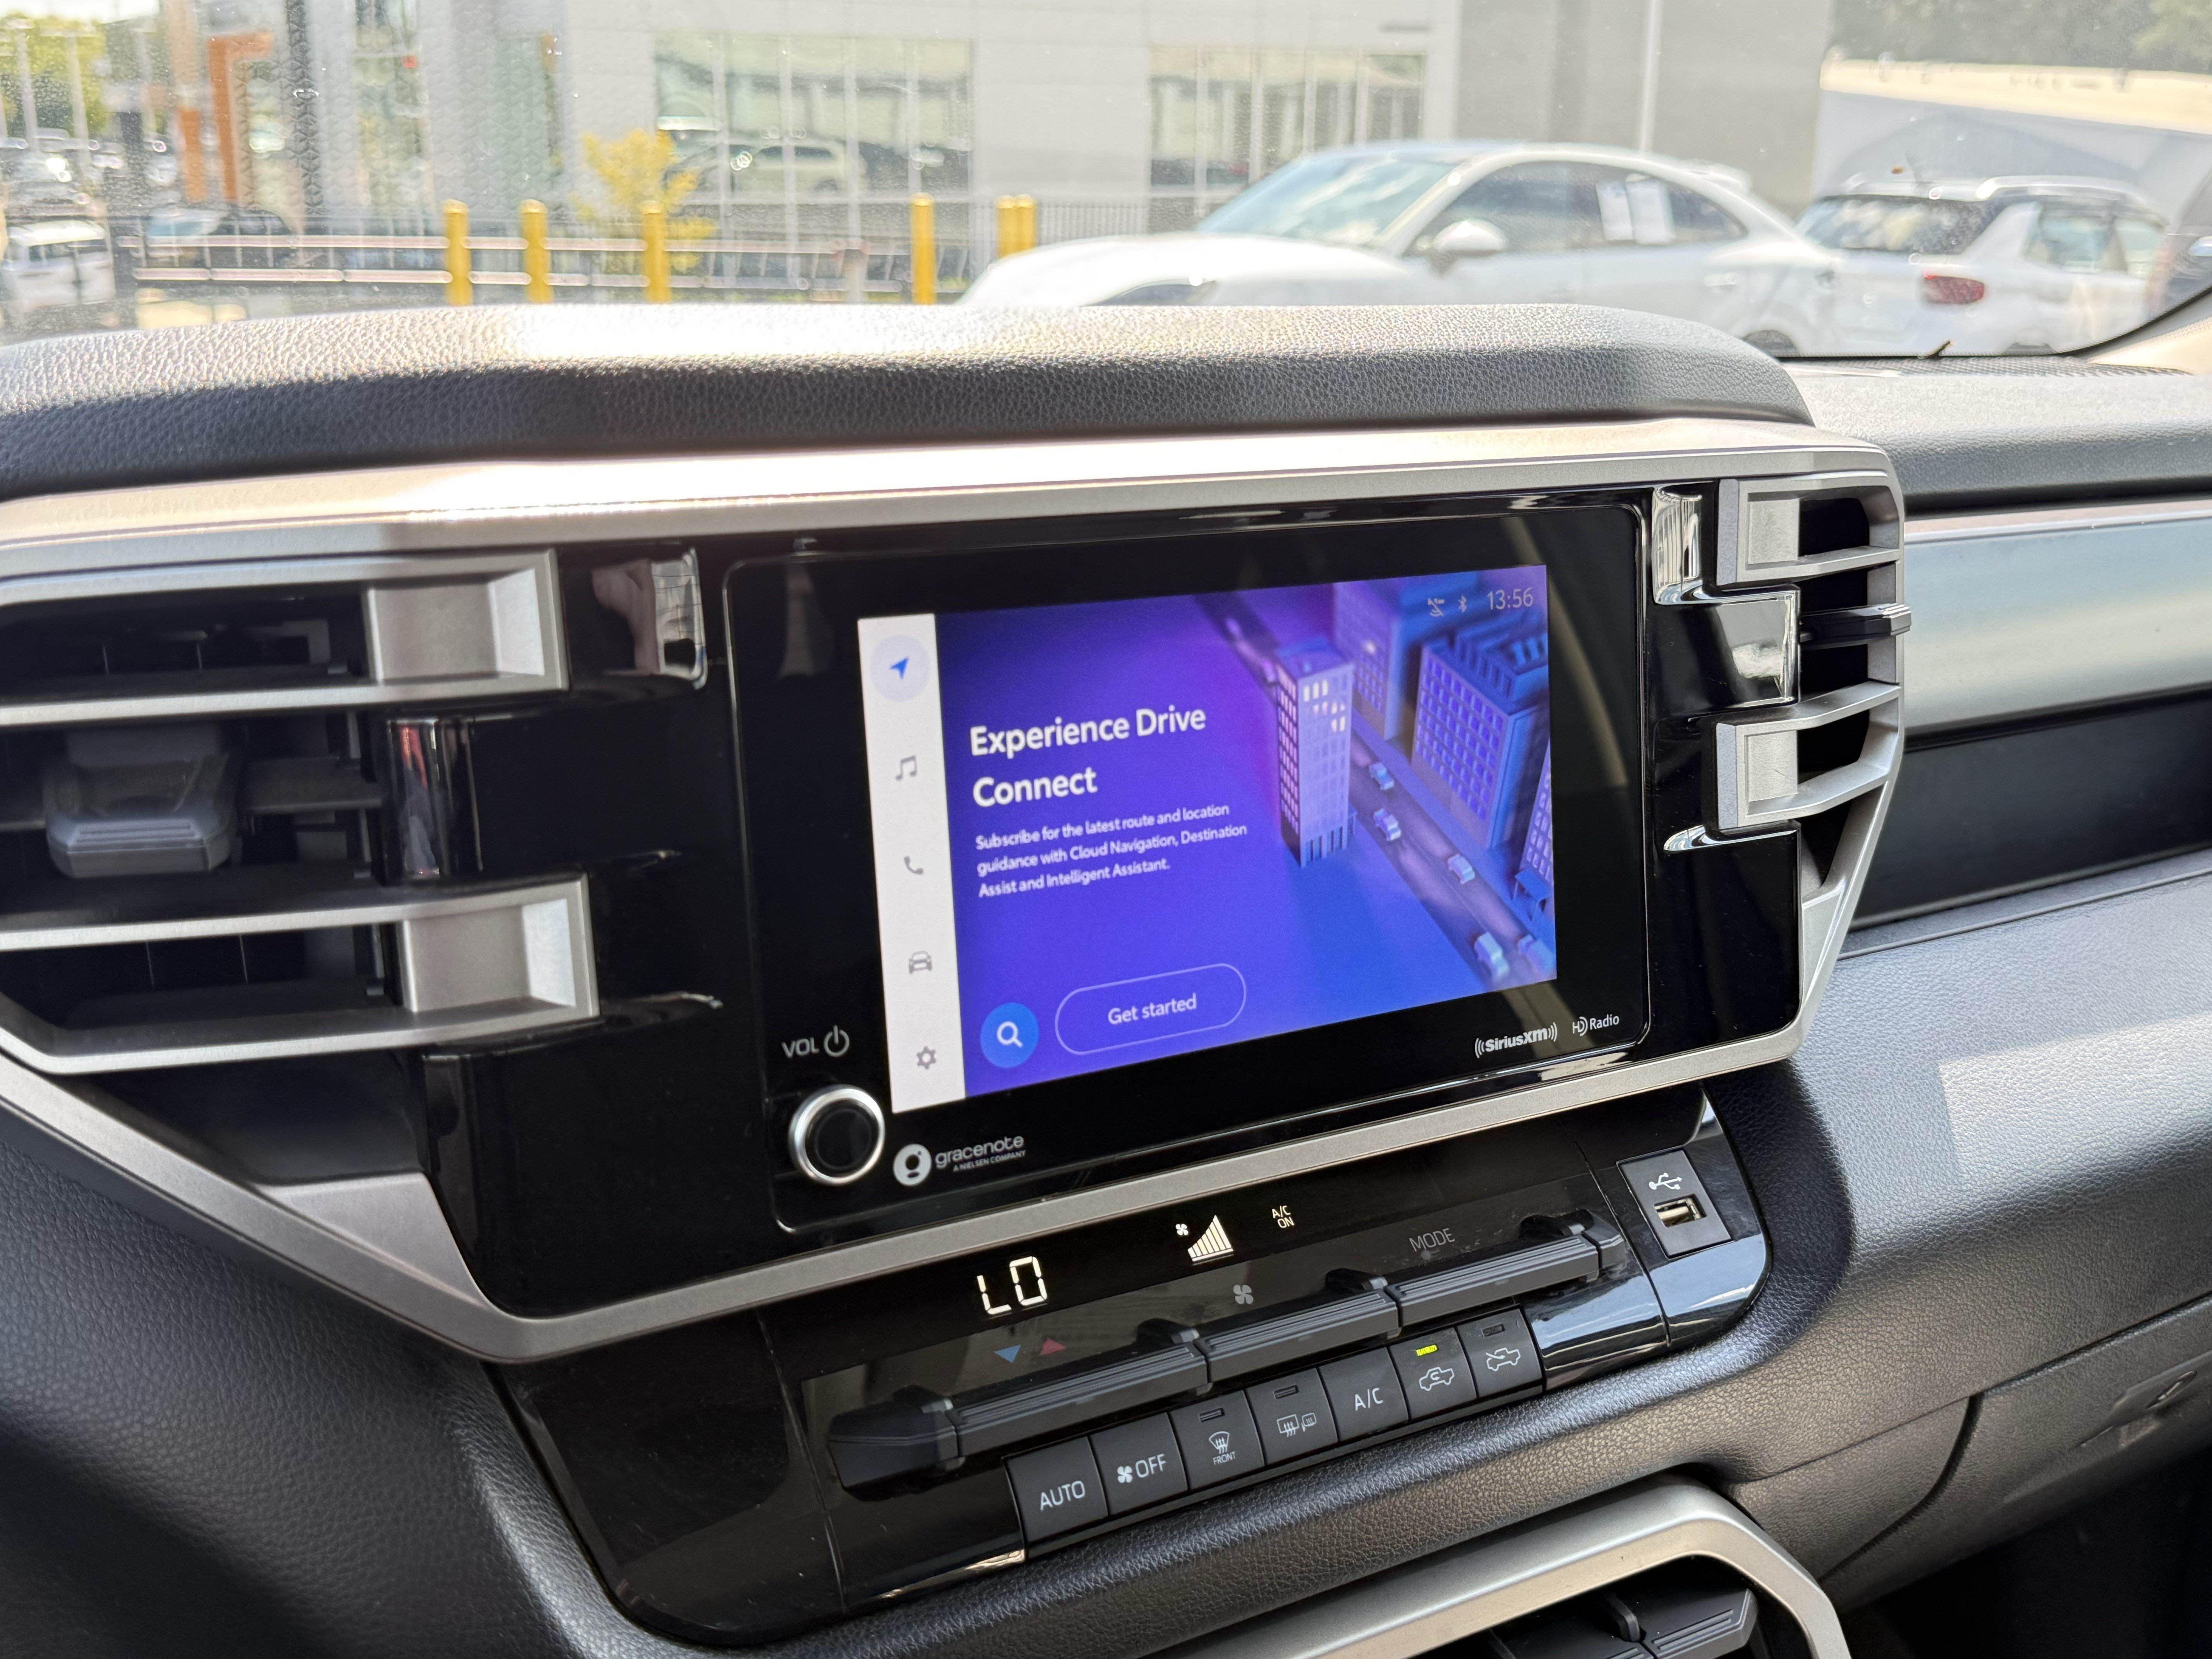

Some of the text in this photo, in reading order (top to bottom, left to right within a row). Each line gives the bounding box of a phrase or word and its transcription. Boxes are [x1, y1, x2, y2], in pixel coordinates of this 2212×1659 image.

[1487, 587, 1534, 610] 13:56
[970, 705, 1206, 759] Experience Drive
[973, 767, 1098, 807] Connect
[975, 804, 1230, 850] Subscribe for the latest route and location
[977, 824, 1247, 877] guidance with Cloud Navigation, Destination
[978, 857, 1170, 898] Assist and Intelligent Assistant.
[1108, 992, 1197, 1025] Get started
[1590, 1014, 1620, 1030] Radio
[781, 1037, 819, 1058] VOL
[935, 1136, 1025, 1169] gracenote
[953, 1150, 1026, 1173] A NIELSEN COMPANY
[1272, 1205, 1291, 1218] A/C
[1277, 1216, 1295, 1228] ON
[1409, 1228, 1455, 1252] MODE
[1355, 1388, 1383, 1411] A/C
[1135, 1453, 1166, 1478] OFF
[1213, 1451, 1236, 1465] FRONT
[1041, 1480, 1085, 1510] AUTO
